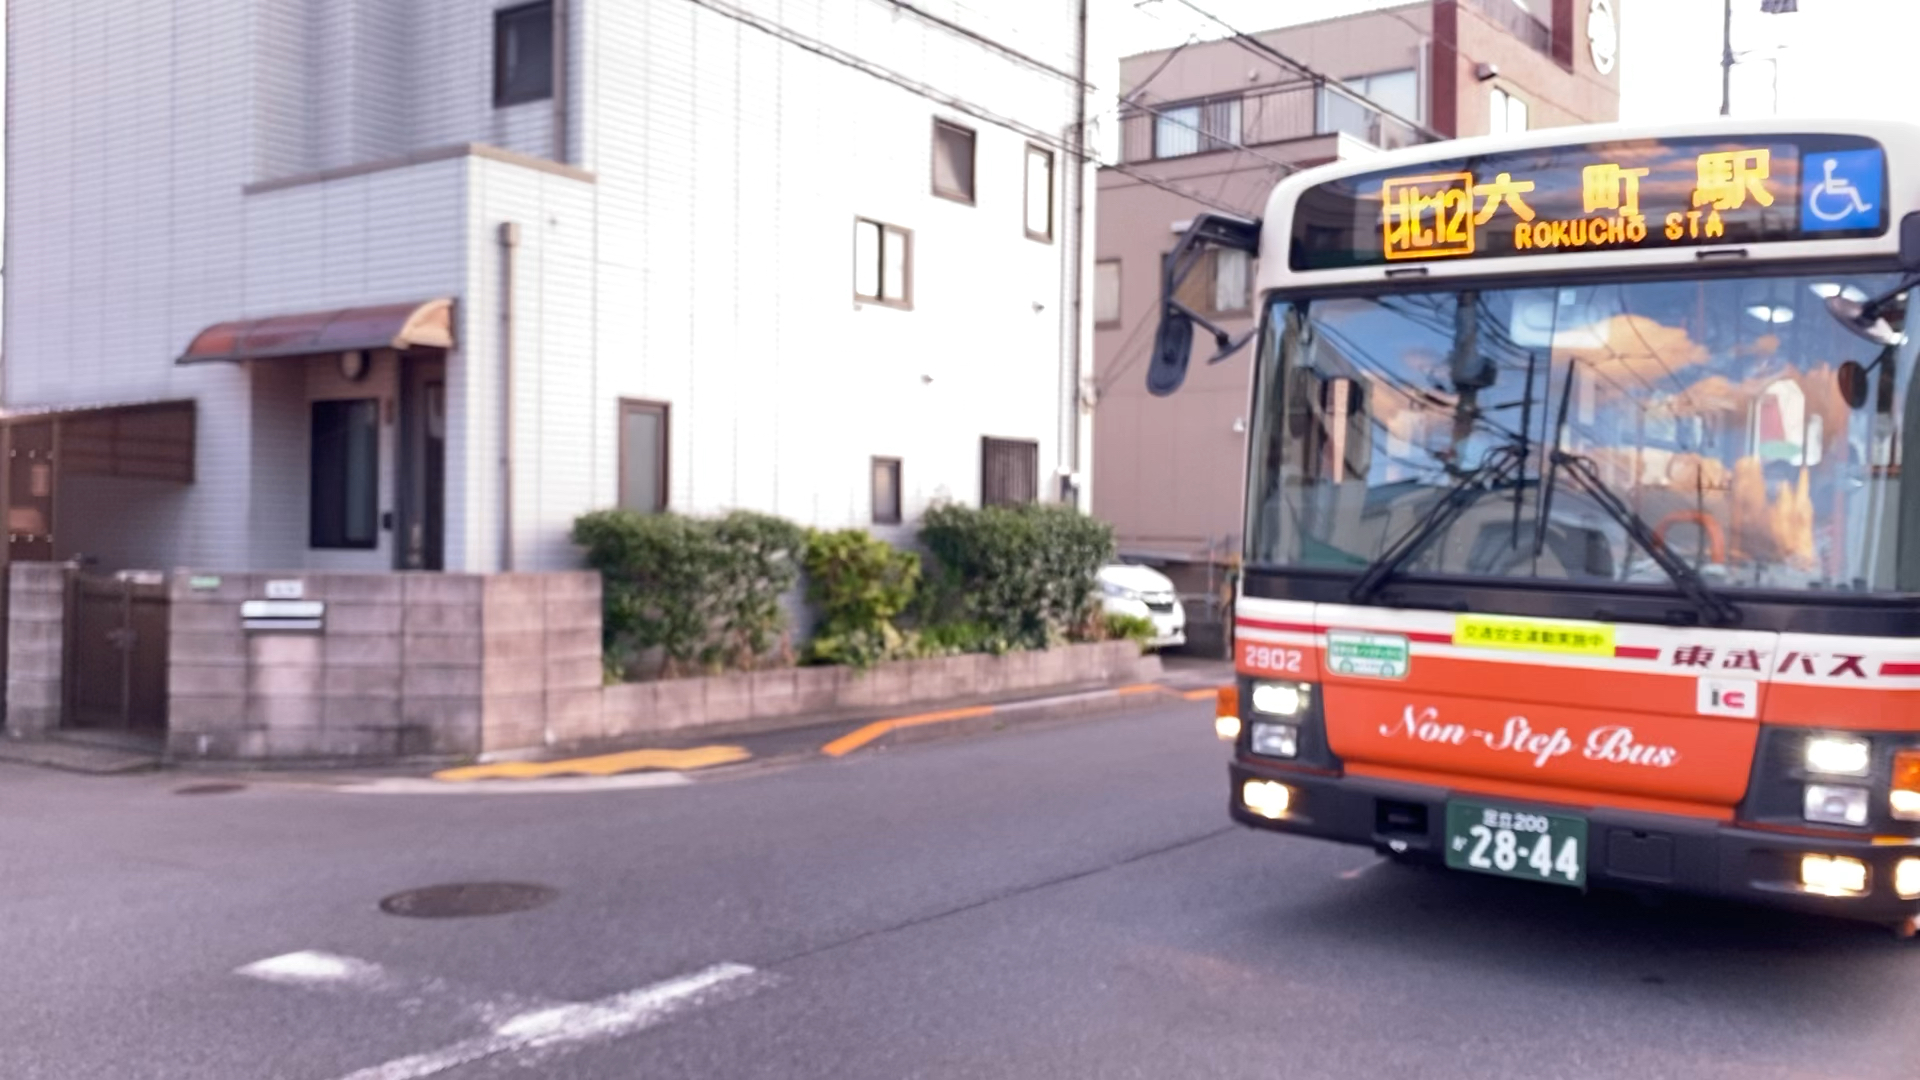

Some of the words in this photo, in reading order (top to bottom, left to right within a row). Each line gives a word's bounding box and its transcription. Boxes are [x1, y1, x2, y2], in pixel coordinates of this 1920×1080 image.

[1665, 209, 1725, 241] STA
[1244, 644, 1302, 674] 2902
[1672, 645, 1868, 679] 東武バス
[1379, 703, 1577, 769] Non-Step
[1582, 724, 1681, 768] Bus
